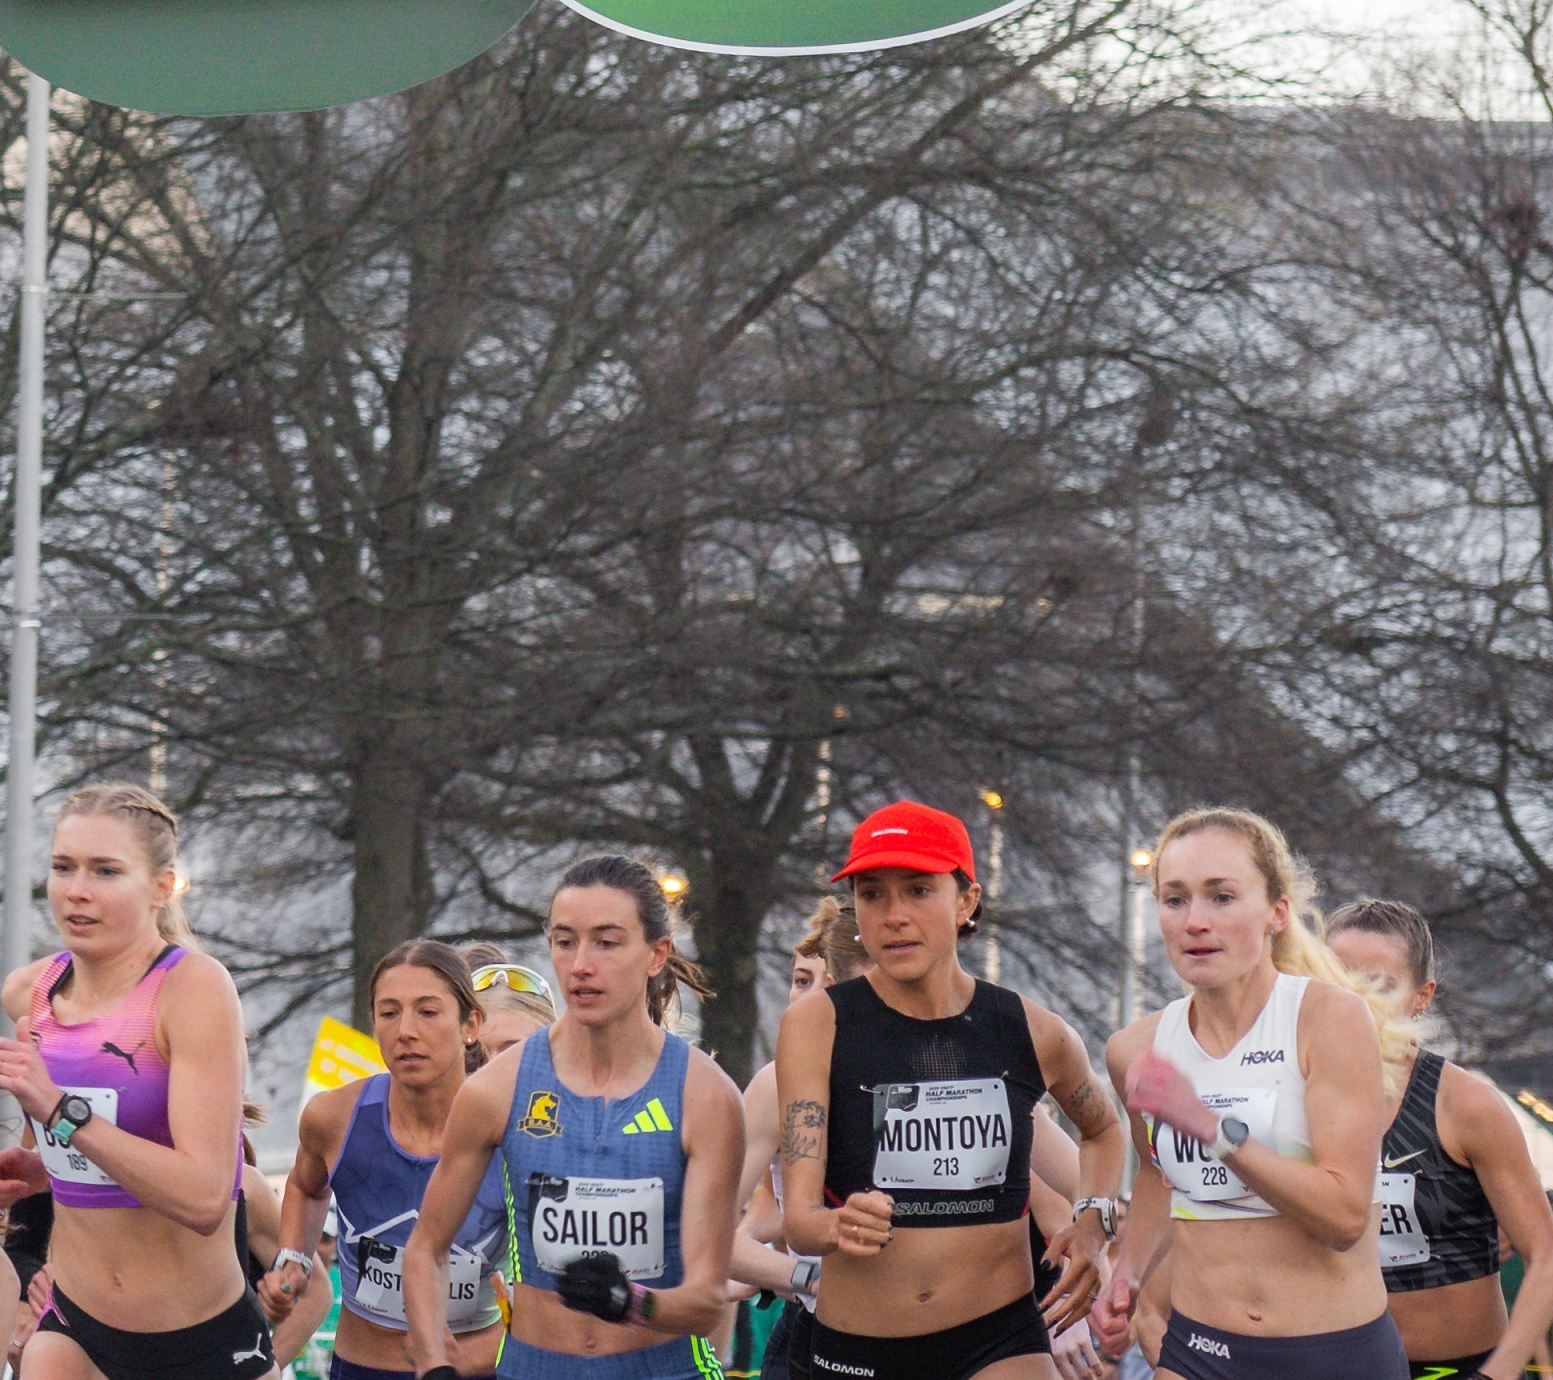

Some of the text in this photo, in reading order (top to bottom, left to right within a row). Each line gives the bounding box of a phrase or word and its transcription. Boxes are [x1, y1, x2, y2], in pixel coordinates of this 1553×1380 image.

[1241, 1050, 1284, 1066] HOKA
[880, 1114, 1007, 1152] MONTOYA
[933, 1158, 959, 1176] 213
[1201, 1167, 1228, 1186] 228
[895, 1200, 994, 1216] SALOMON
[543, 1207, 648, 1246] SAILOR
[1187, 1333, 1231, 1359] HOKA
[814, 1355, 875, 1377] SALOMON
